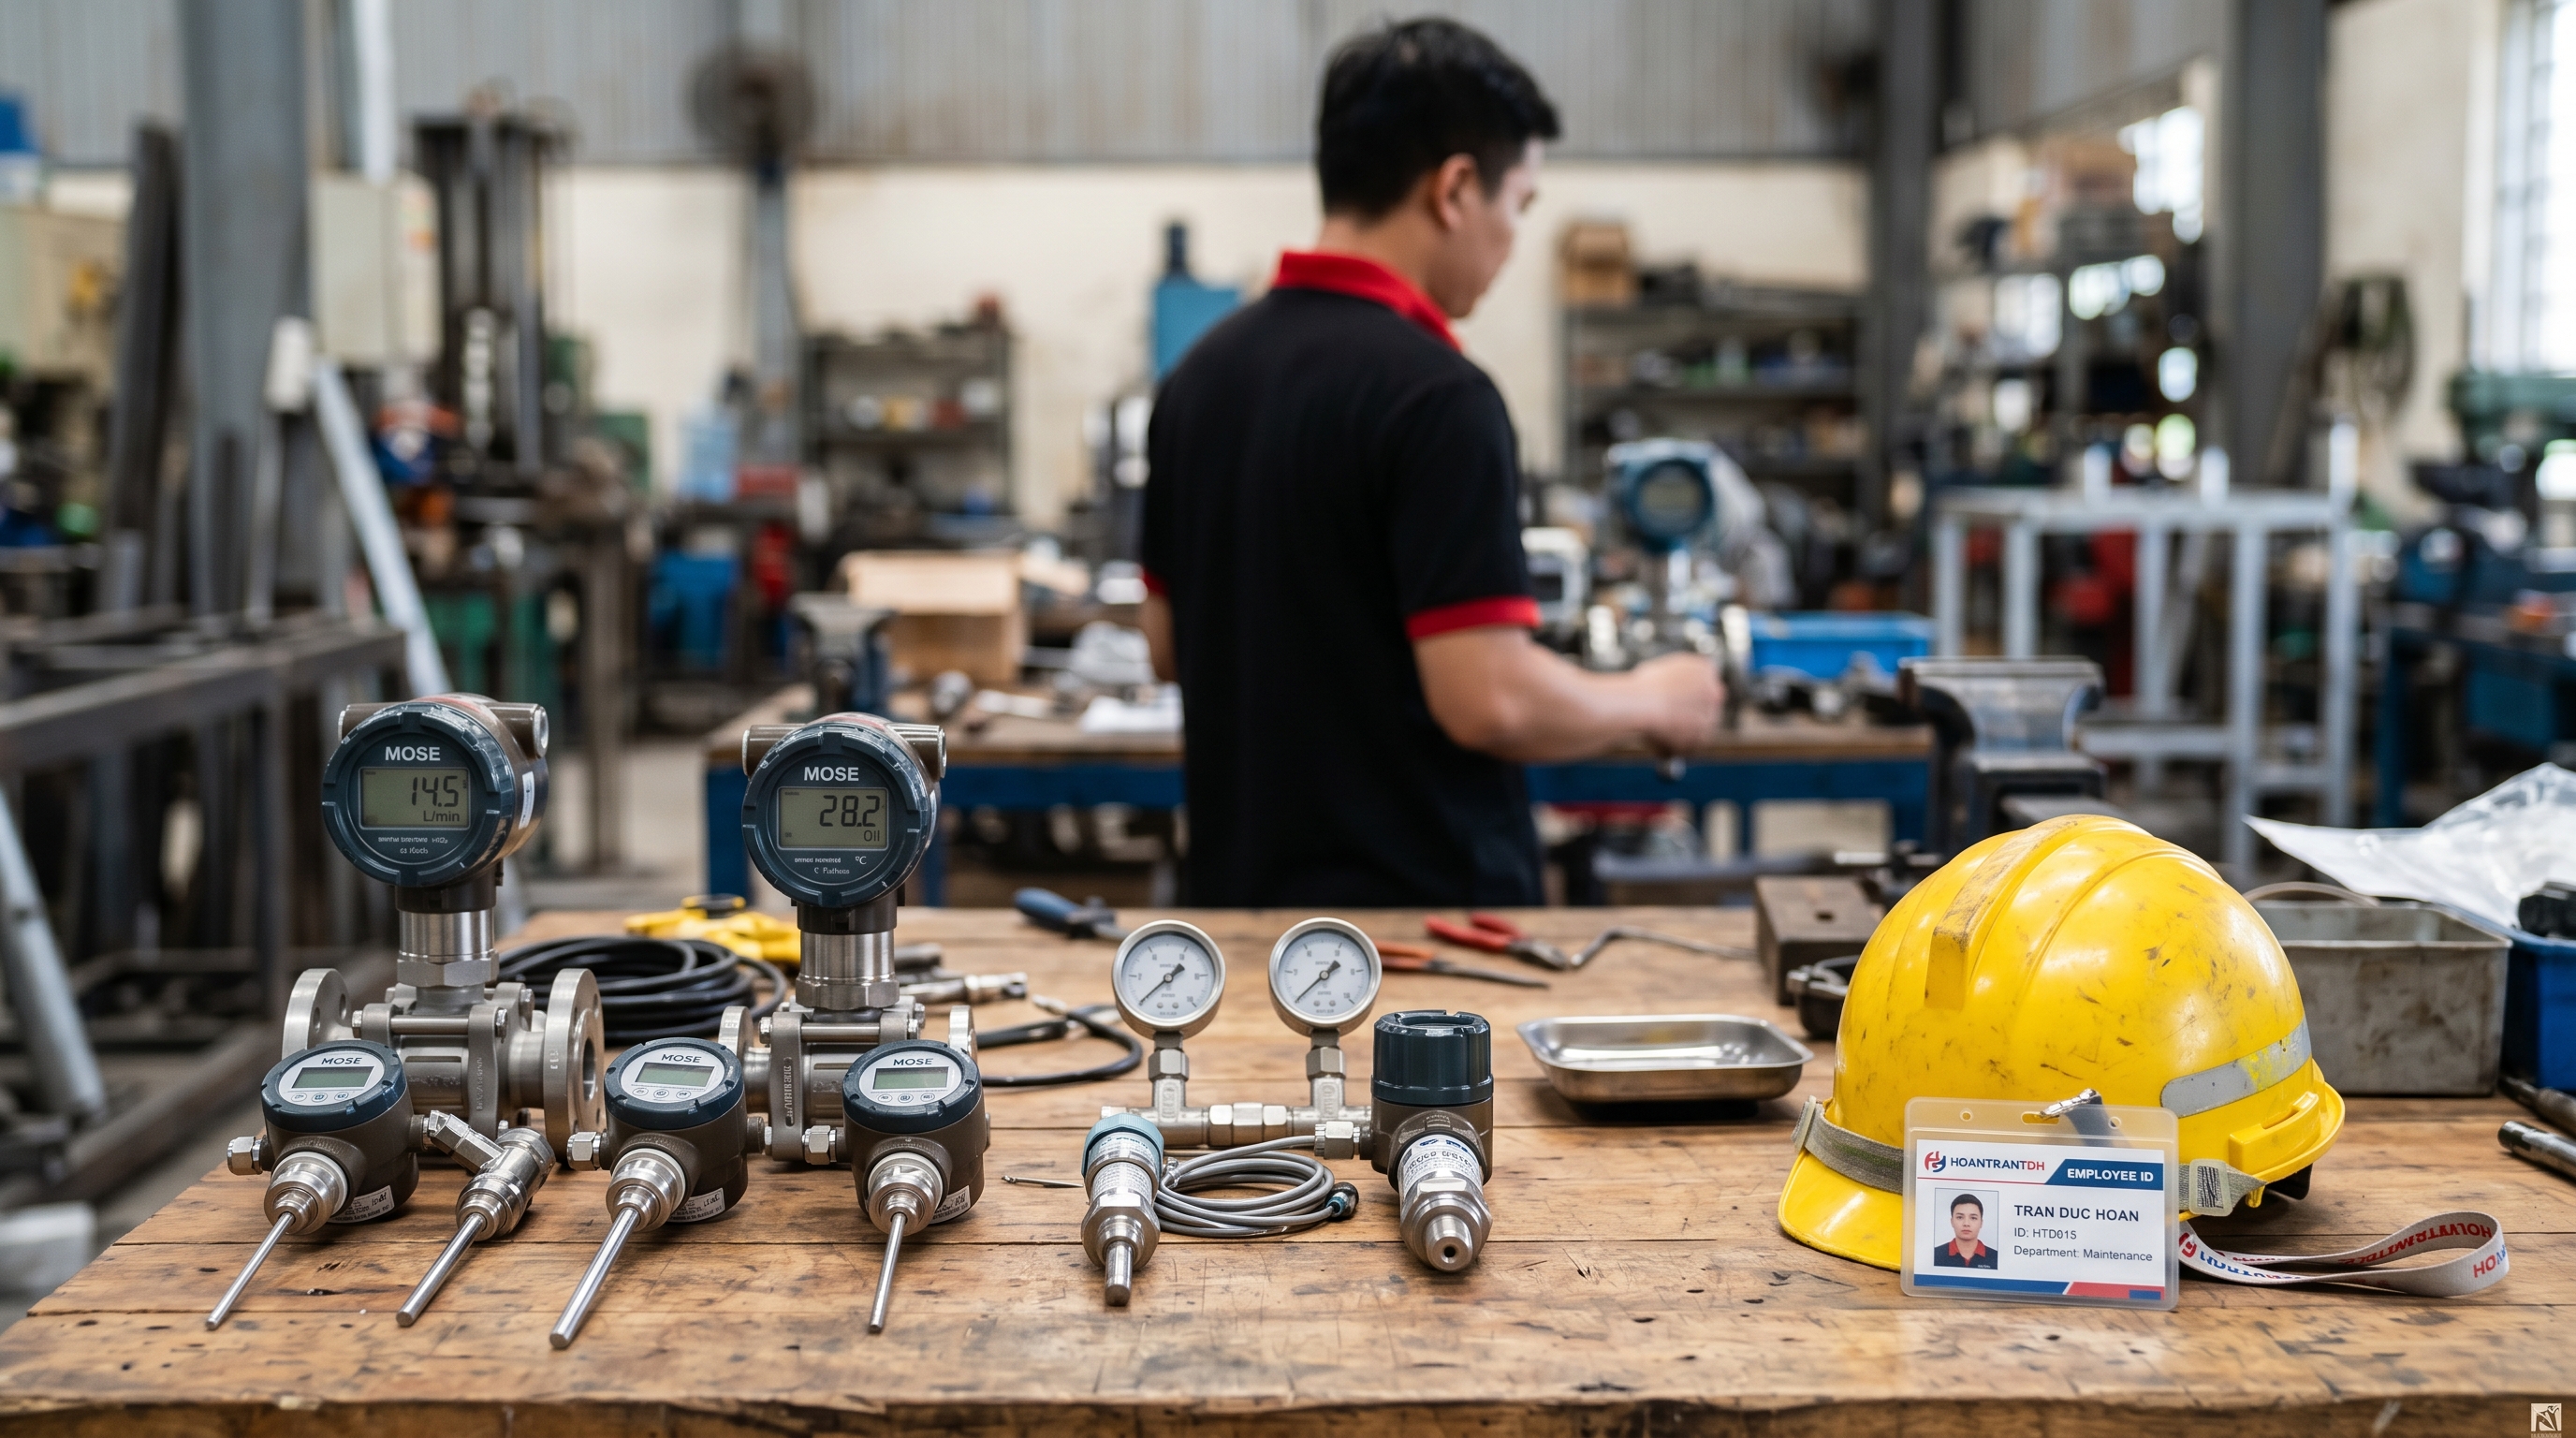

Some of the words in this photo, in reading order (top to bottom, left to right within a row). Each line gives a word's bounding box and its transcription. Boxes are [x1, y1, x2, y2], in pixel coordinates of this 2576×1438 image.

[385, 746, 441, 761] MOSE
[803, 766, 859, 782] MOSE
[411, 775, 459, 808] 14.5
[423, 810, 461, 822] L/min
[819, 795, 880, 828] 28.2
[321, 1057, 363, 1065] MOSE
[661, 1053, 702, 1064] MOSE
[893, 1057, 934, 1066] MOSE
[1950, 1157, 2045, 1171] HOANTRANTDH
[2067, 1167, 2137, 1181] EMPLOYEE
[2140, 1171, 2154, 1182] ID
[2013, 1205, 2055, 1218] TRAN
[2059, 1207, 2090, 1220] DUC
[2096, 1209, 2139, 1222] HOAN
[2013, 1227, 2029, 1238] ID:
[2013, 1245, 2079, 1258] Department:
[2083, 1249, 2153, 1261] Maintenance
